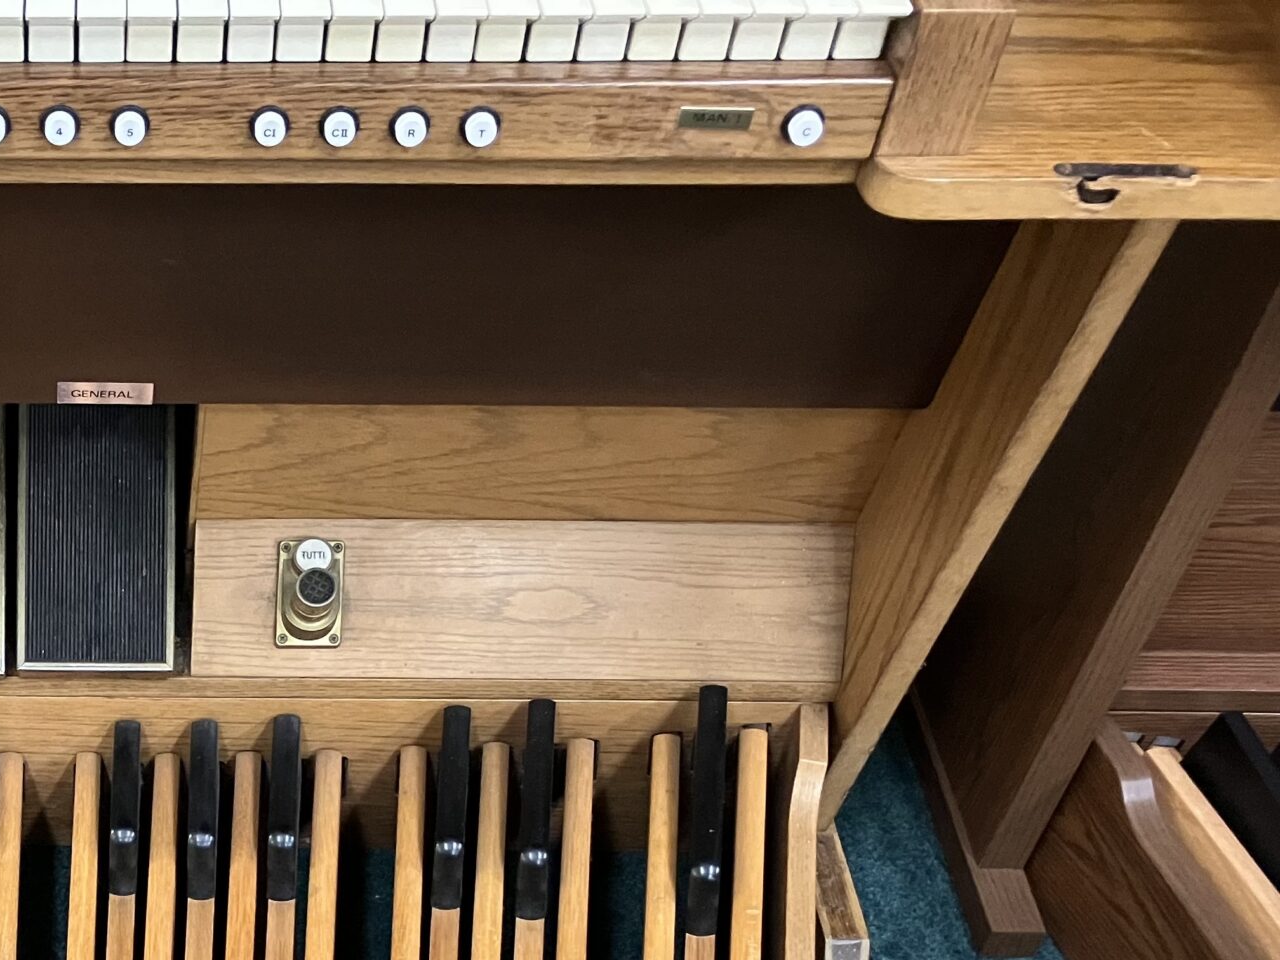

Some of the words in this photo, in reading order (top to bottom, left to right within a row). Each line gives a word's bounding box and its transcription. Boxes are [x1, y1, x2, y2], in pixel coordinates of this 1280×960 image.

[692, 112, 728, 123] MAN
[56, 128, 63, 136] 4
[127, 129, 134, 137] 5
[407, 129, 416, 138] R
[478, 129, 486, 138] T
[802, 128, 812, 137] C
[70, 389, 134, 399] GENERAL
[302, 551, 326, 560] TUTTI
